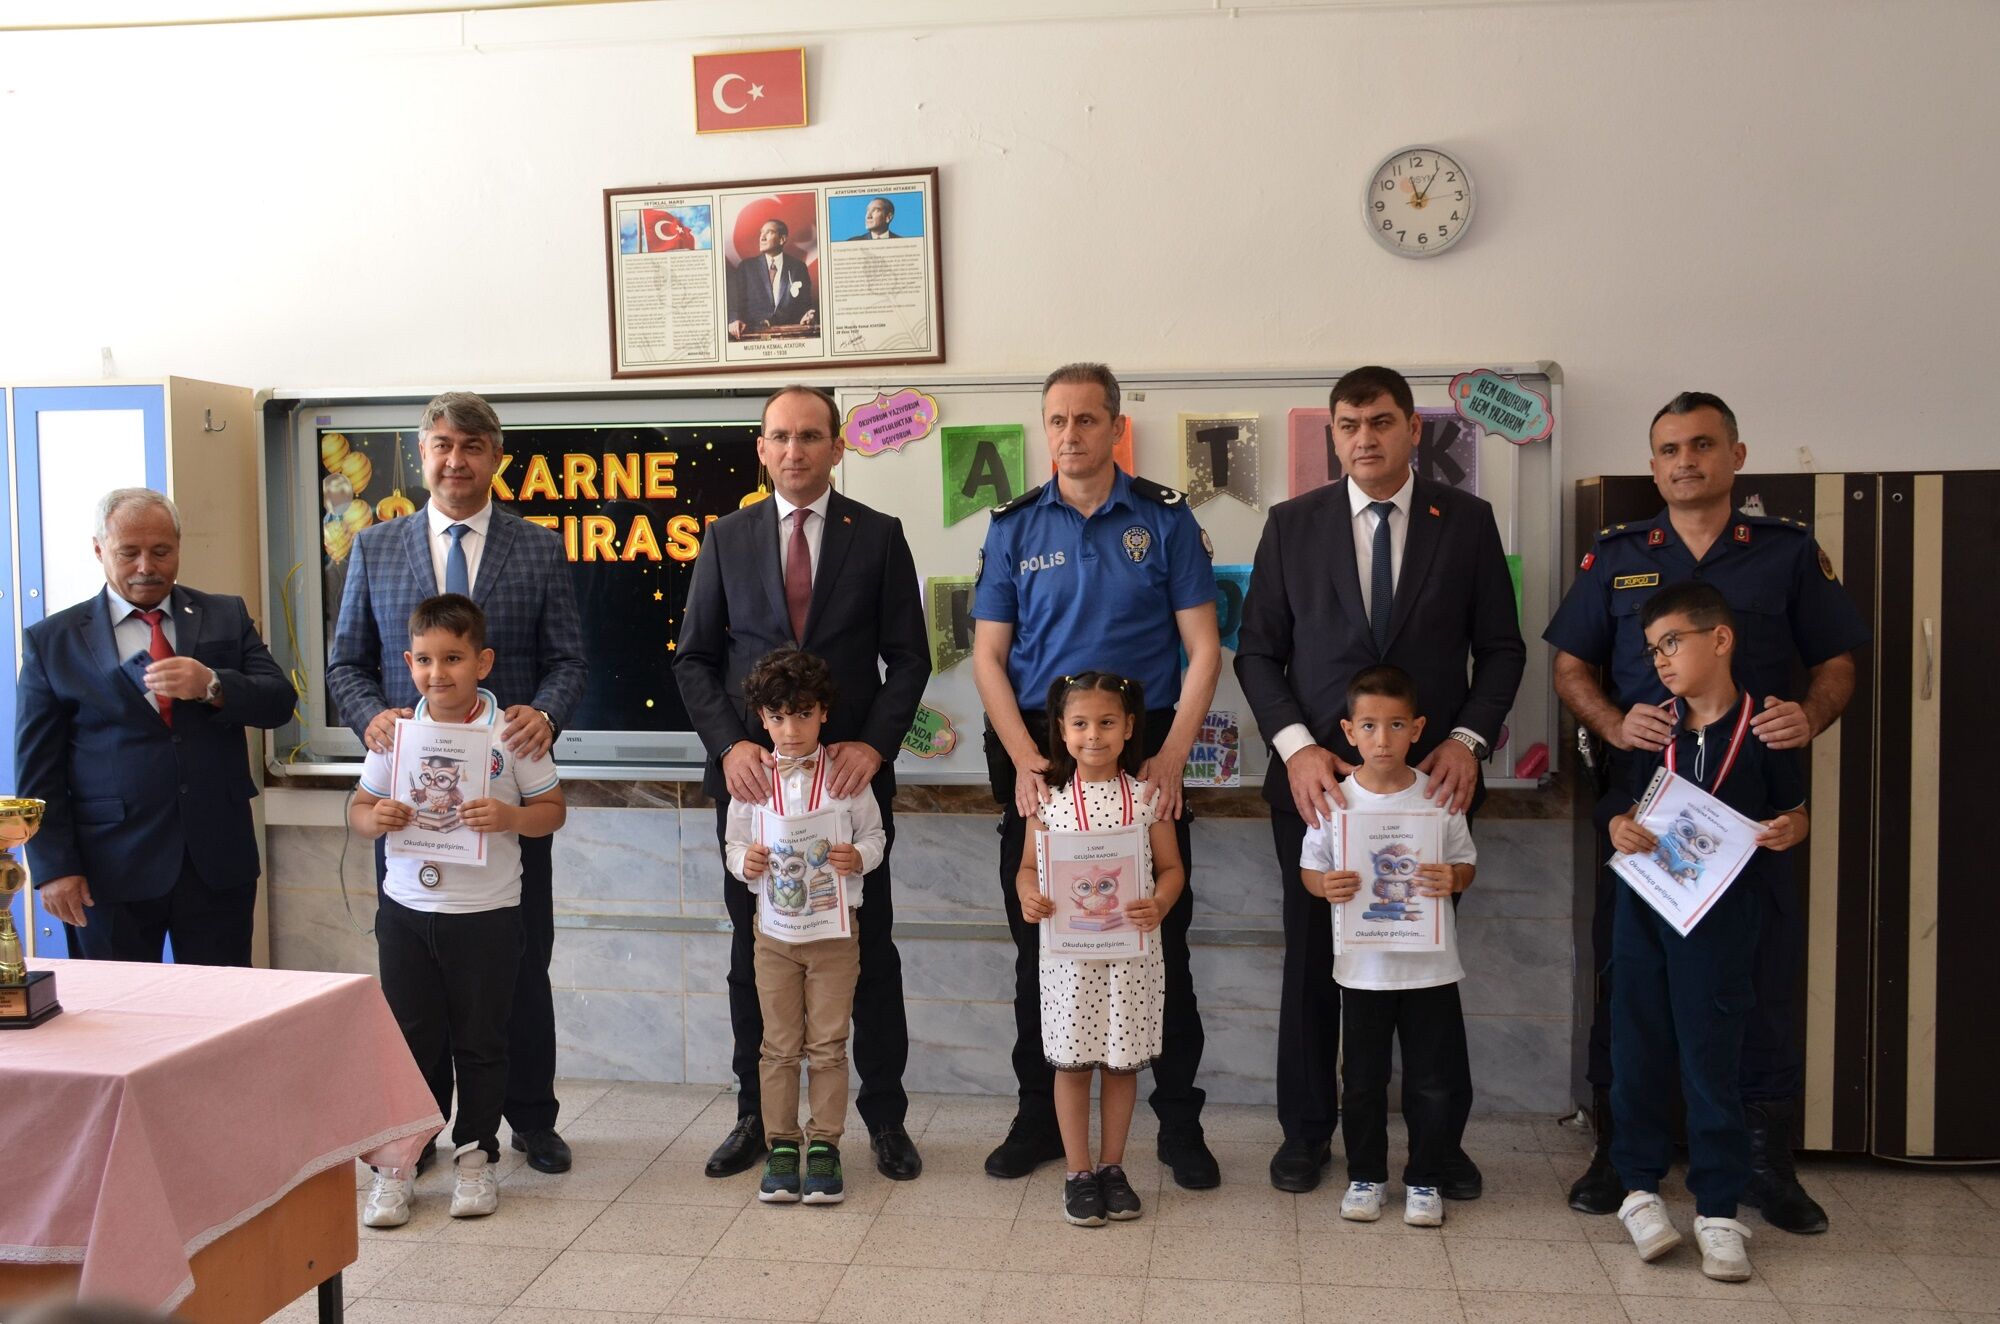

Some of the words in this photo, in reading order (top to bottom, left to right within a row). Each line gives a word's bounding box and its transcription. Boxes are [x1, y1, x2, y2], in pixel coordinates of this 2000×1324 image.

[1409, 156, 1424, 169] 12
[1392, 165, 1402, 177] 11
[1445, 171, 1456, 183] 2
[1380, 179, 1395, 192] 10
[1454, 190, 1464, 202] 3
[1374, 201, 1385, 213] 9
[1450, 210, 1460, 221] 4
[1382, 219, 1393, 231] 8
[1438, 225, 1448, 237] 5
[1396, 230, 1407, 242] 7
[1417, 233, 1429, 244] 6
[1477, 378, 1499, 399] HEM
[858, 411, 888, 428] OKUYORUM
[888, 400, 920, 417] YAZIYORUM
[1468, 395, 1491, 416] HEM
[1488, 404, 1526, 433] YAZARIM
[873, 416, 913, 435] MUTLULUKTAN
[881, 429, 912, 446] UÇUYORUM
[961, 440, 1012, 505] A
[1196, 425, 1239, 488] T
[1418, 420, 1467, 486] K
[523, 514, 719, 562] IRAS
[403, 839, 436, 849] Okudukça
[1628, 860, 1656, 886] Okudukça
[773, 920, 801, 930] Okudukça
[1355, 930, 1389, 938] Okudukça
[1062, 941, 1095, 949] Okudukça
